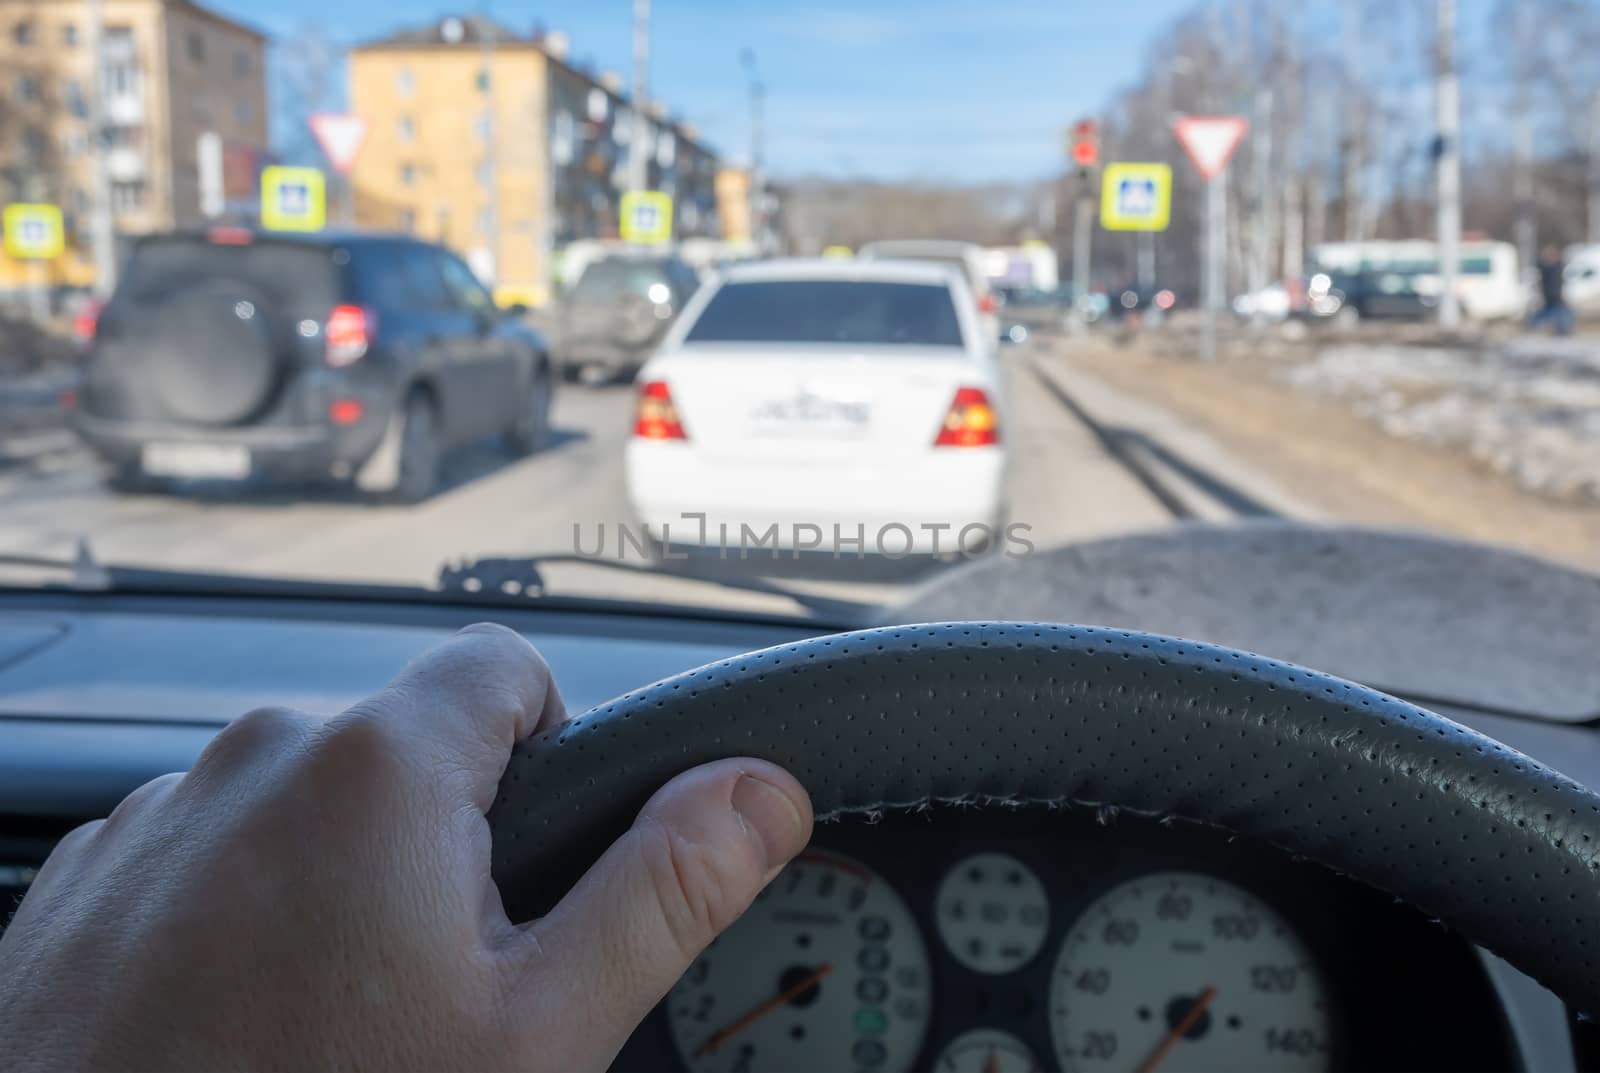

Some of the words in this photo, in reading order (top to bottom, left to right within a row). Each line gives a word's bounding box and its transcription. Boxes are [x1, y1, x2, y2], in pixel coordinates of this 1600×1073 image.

[1156, 893, 1193, 921] 80
[1212, 914, 1259, 941] 100
[1075, 967, 1110, 995] 40
[1250, 965, 1297, 993] 120
[1081, 1030, 1118, 1060] 20
[1265, 1028, 1315, 1058] 140
